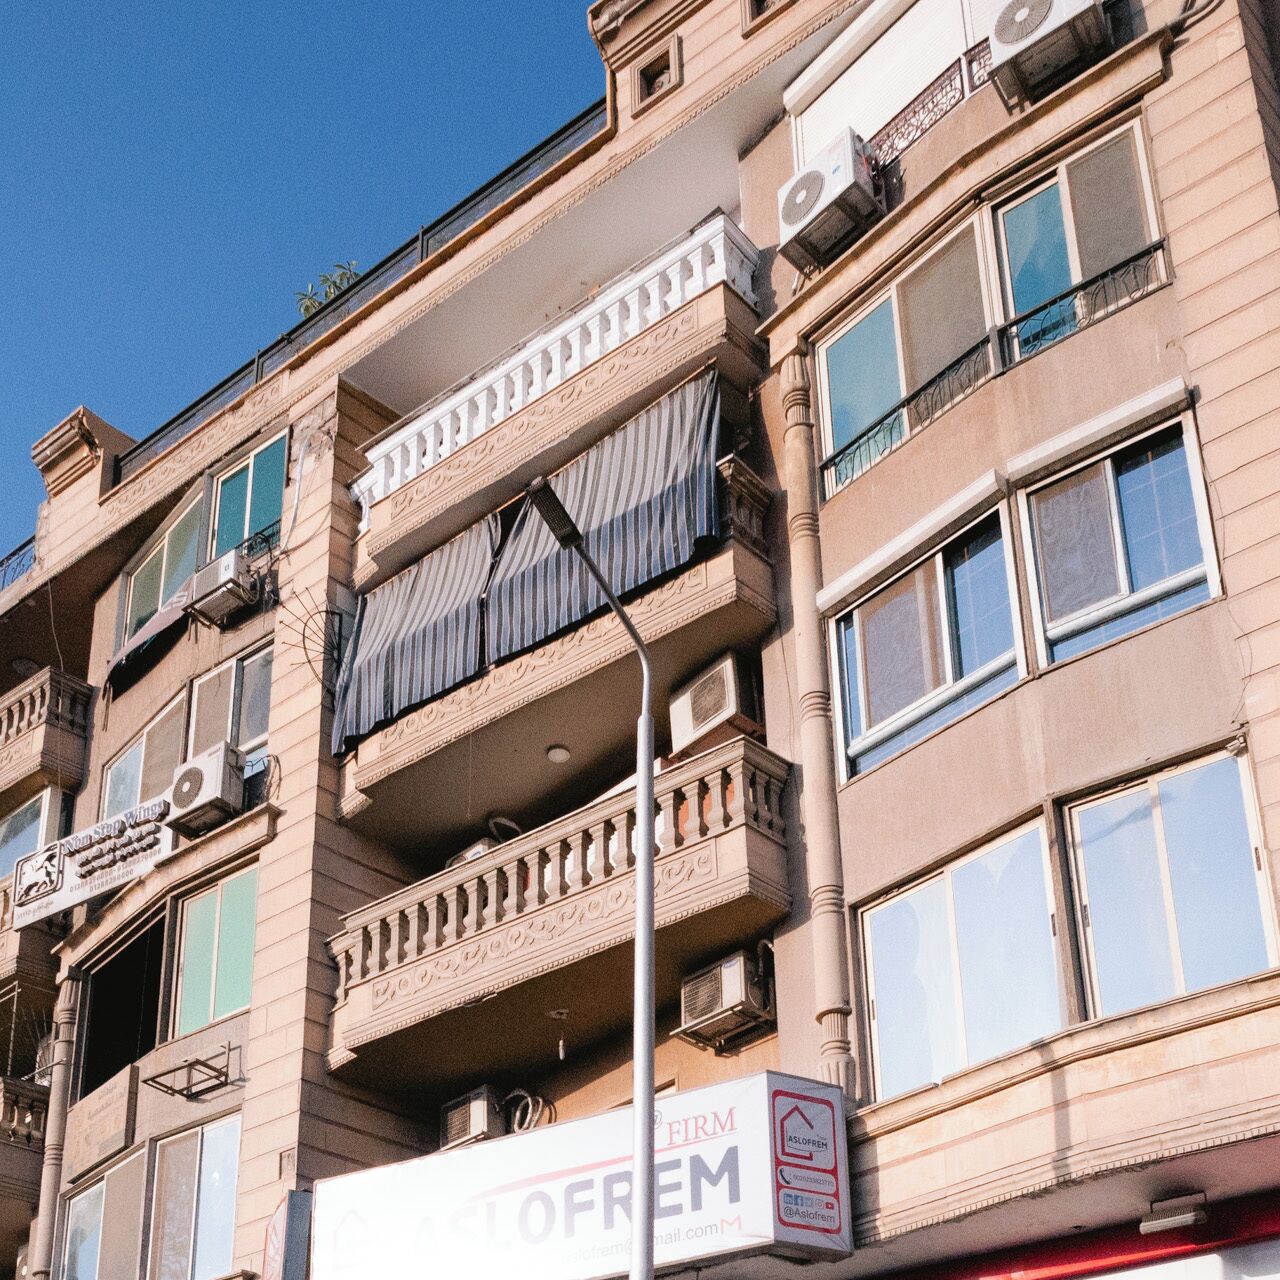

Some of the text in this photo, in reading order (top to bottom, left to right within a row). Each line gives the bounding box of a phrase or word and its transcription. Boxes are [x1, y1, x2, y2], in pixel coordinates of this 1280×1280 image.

[666, 1106, 737, 1145] FIRM
[788, 1135, 828, 1149] ASLOFREM
[783, 1206, 835, 1223] @Aslofrem
